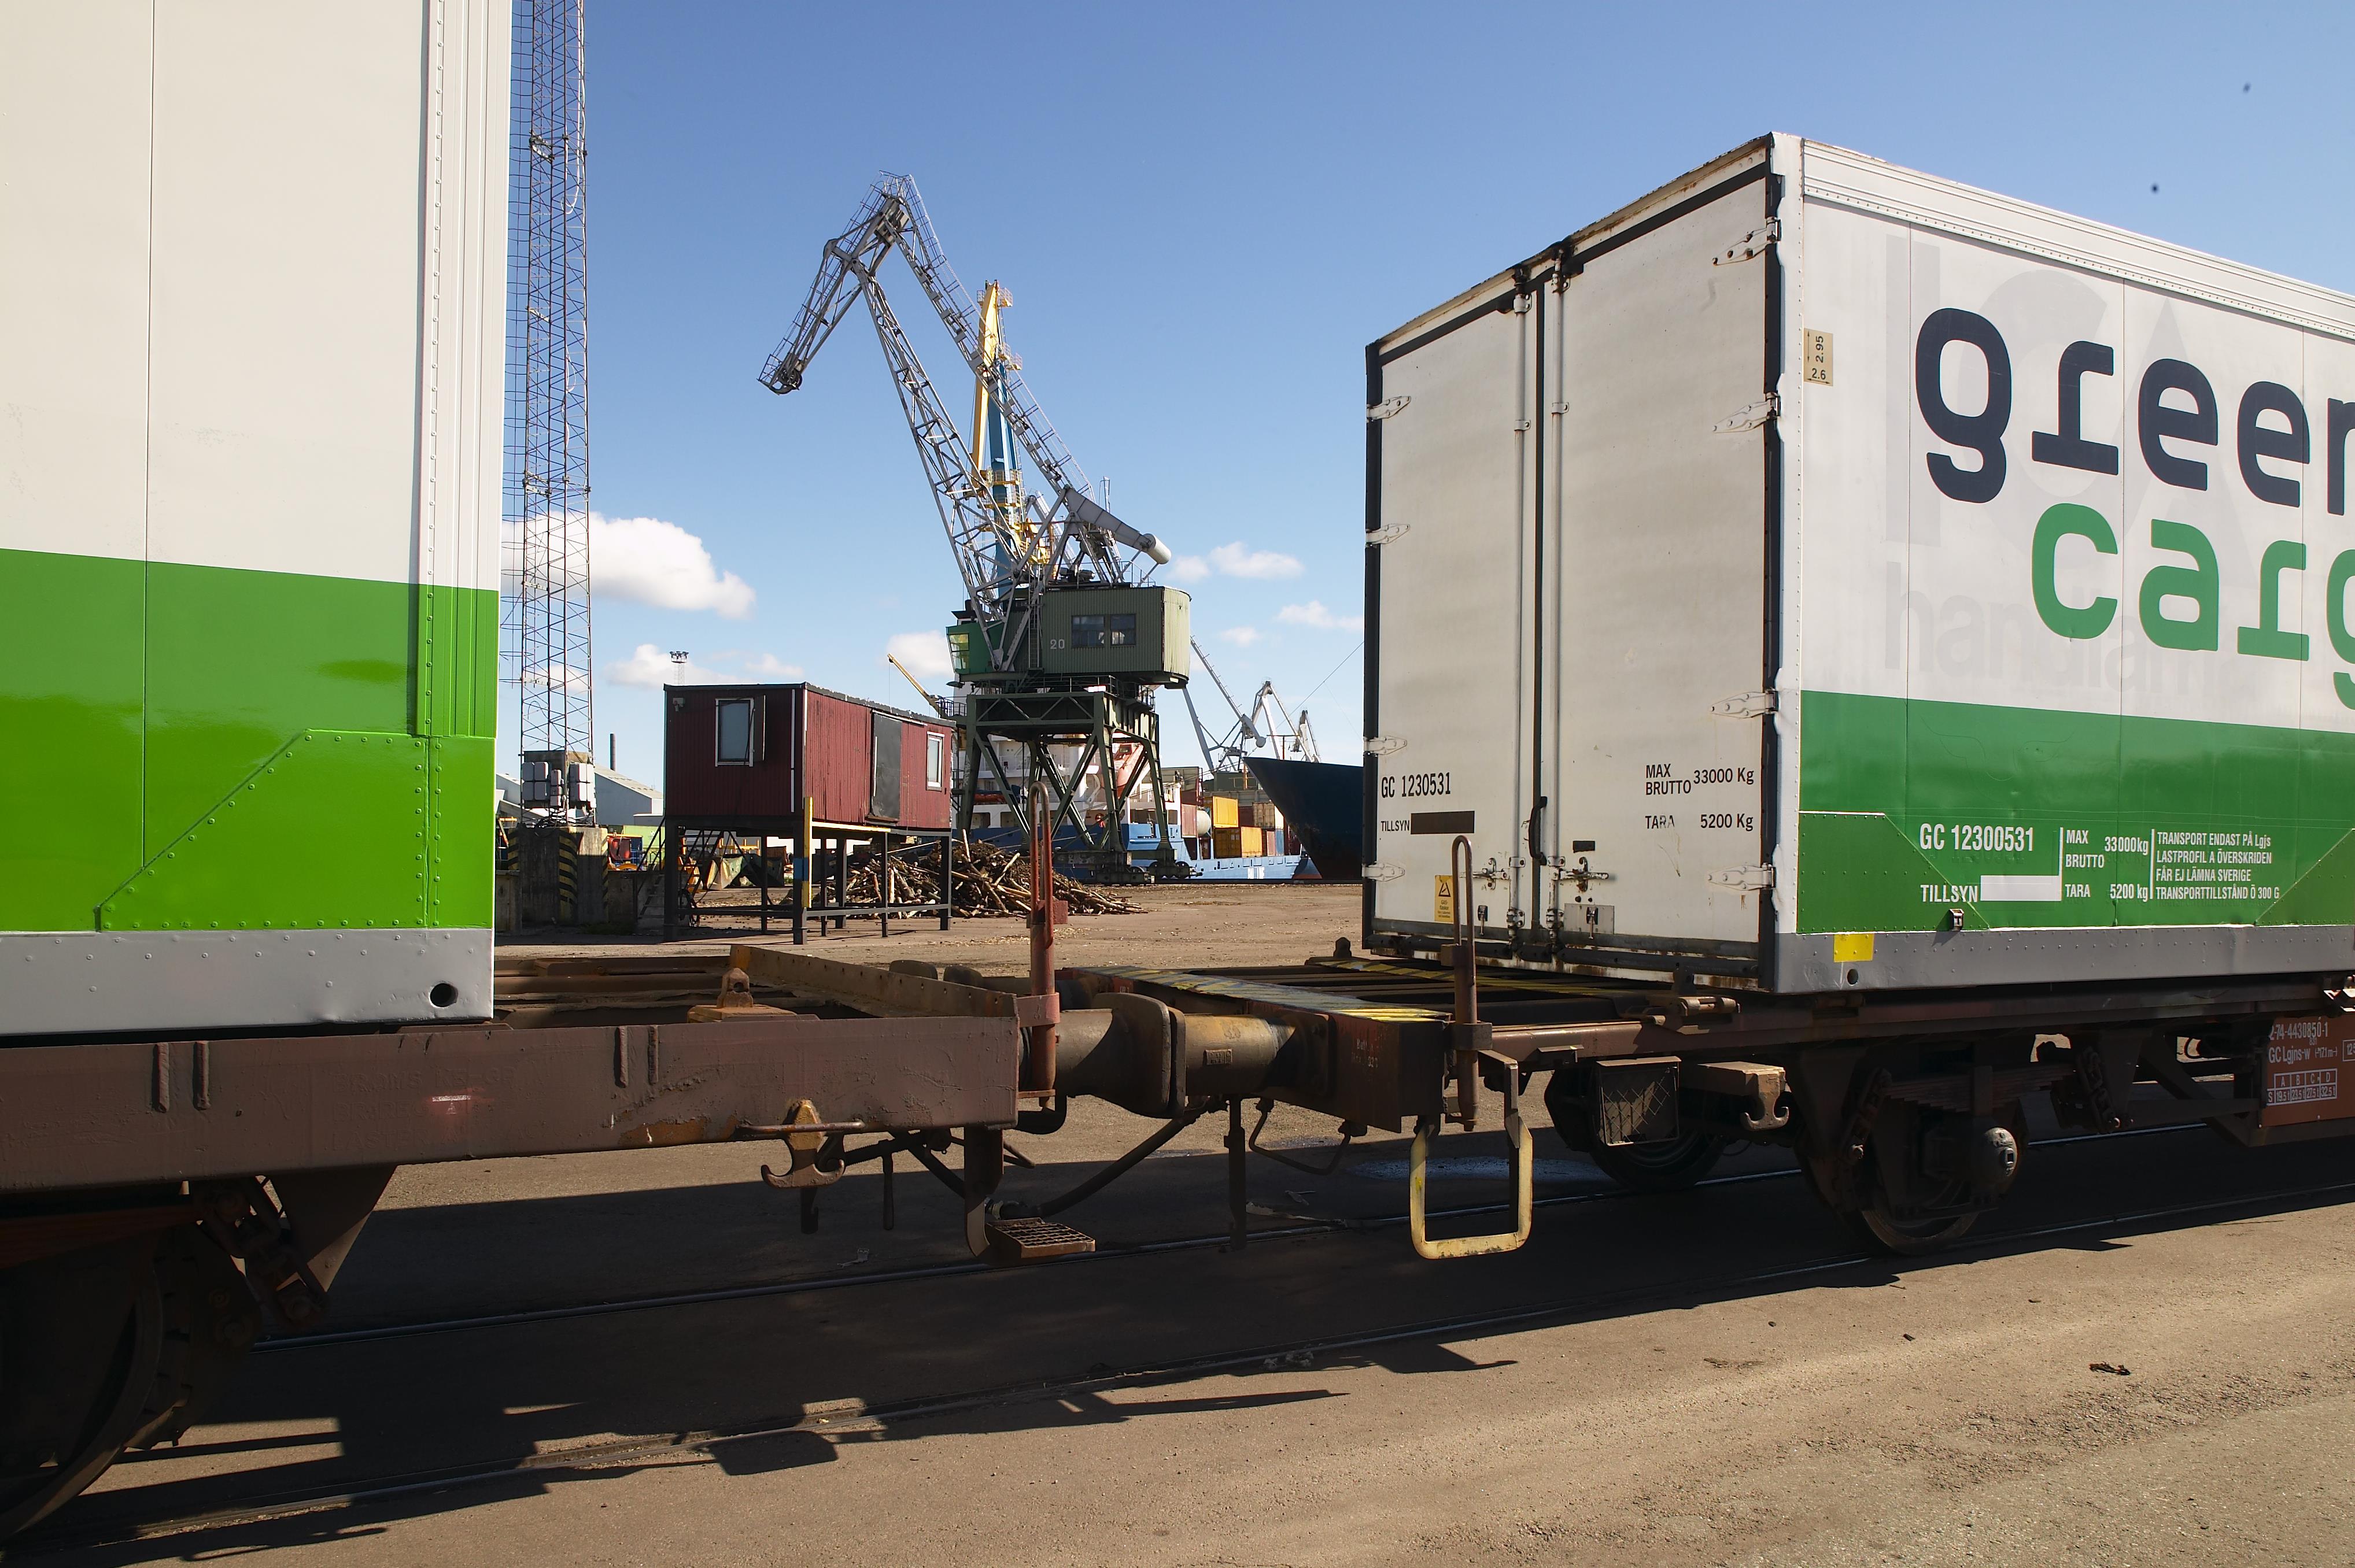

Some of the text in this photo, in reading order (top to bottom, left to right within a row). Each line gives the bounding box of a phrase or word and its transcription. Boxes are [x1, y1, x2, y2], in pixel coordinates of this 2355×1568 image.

[1815, 336, 1824, 363] 2.95
[1811, 368, 1826, 380] 2.6
[1050, 639, 1065, 649] 20
[1646, 764, 1671, 778] MAX
[1693, 767, 1754, 785] 33000 Kg
[1381, 772, 1450, 798] GC 1230531
[1646, 780, 1691, 795] BRUTTO
[1381, 820, 1409, 831] TILLSYN
[1645, 815, 1675, 829] TARA
[1700, 813, 1754, 831] 5200 Kg
[1920, 823, 2033, 851] GC 12300531
[2066, 830, 2088, 844] MAX
[2157, 831, 2271, 849] TRANSPORT ENDAST PÅ Lgjs
[2065, 854, 2105, 868] BRUTTO
[2157, 848, 2272, 864] LASTPROFIL A ÖVERSKRIDEN
[2156, 865, 2251, 882] FÅR EJ LÄMNA SVERIGE
[1920, 885, 1978, 903] TILLSYN
[2065, 884, 2091, 897] TARA
[2110, 883, 2149, 903] 5200 kg
[2155, 883, 2248, 899] TRANSPORTTILLSTÅND
[2258, 887, 2271, 899] 300
[2269, 1046, 2281, 1063] GC
[2281, 1076, 2285, 1087] A
[2296, 1075, 2300, 1085] B
[2310, 1073, 2315, 1083] C
[2326, 1072, 2330, 1082] D
[2268, 1092, 2273, 1103] S
